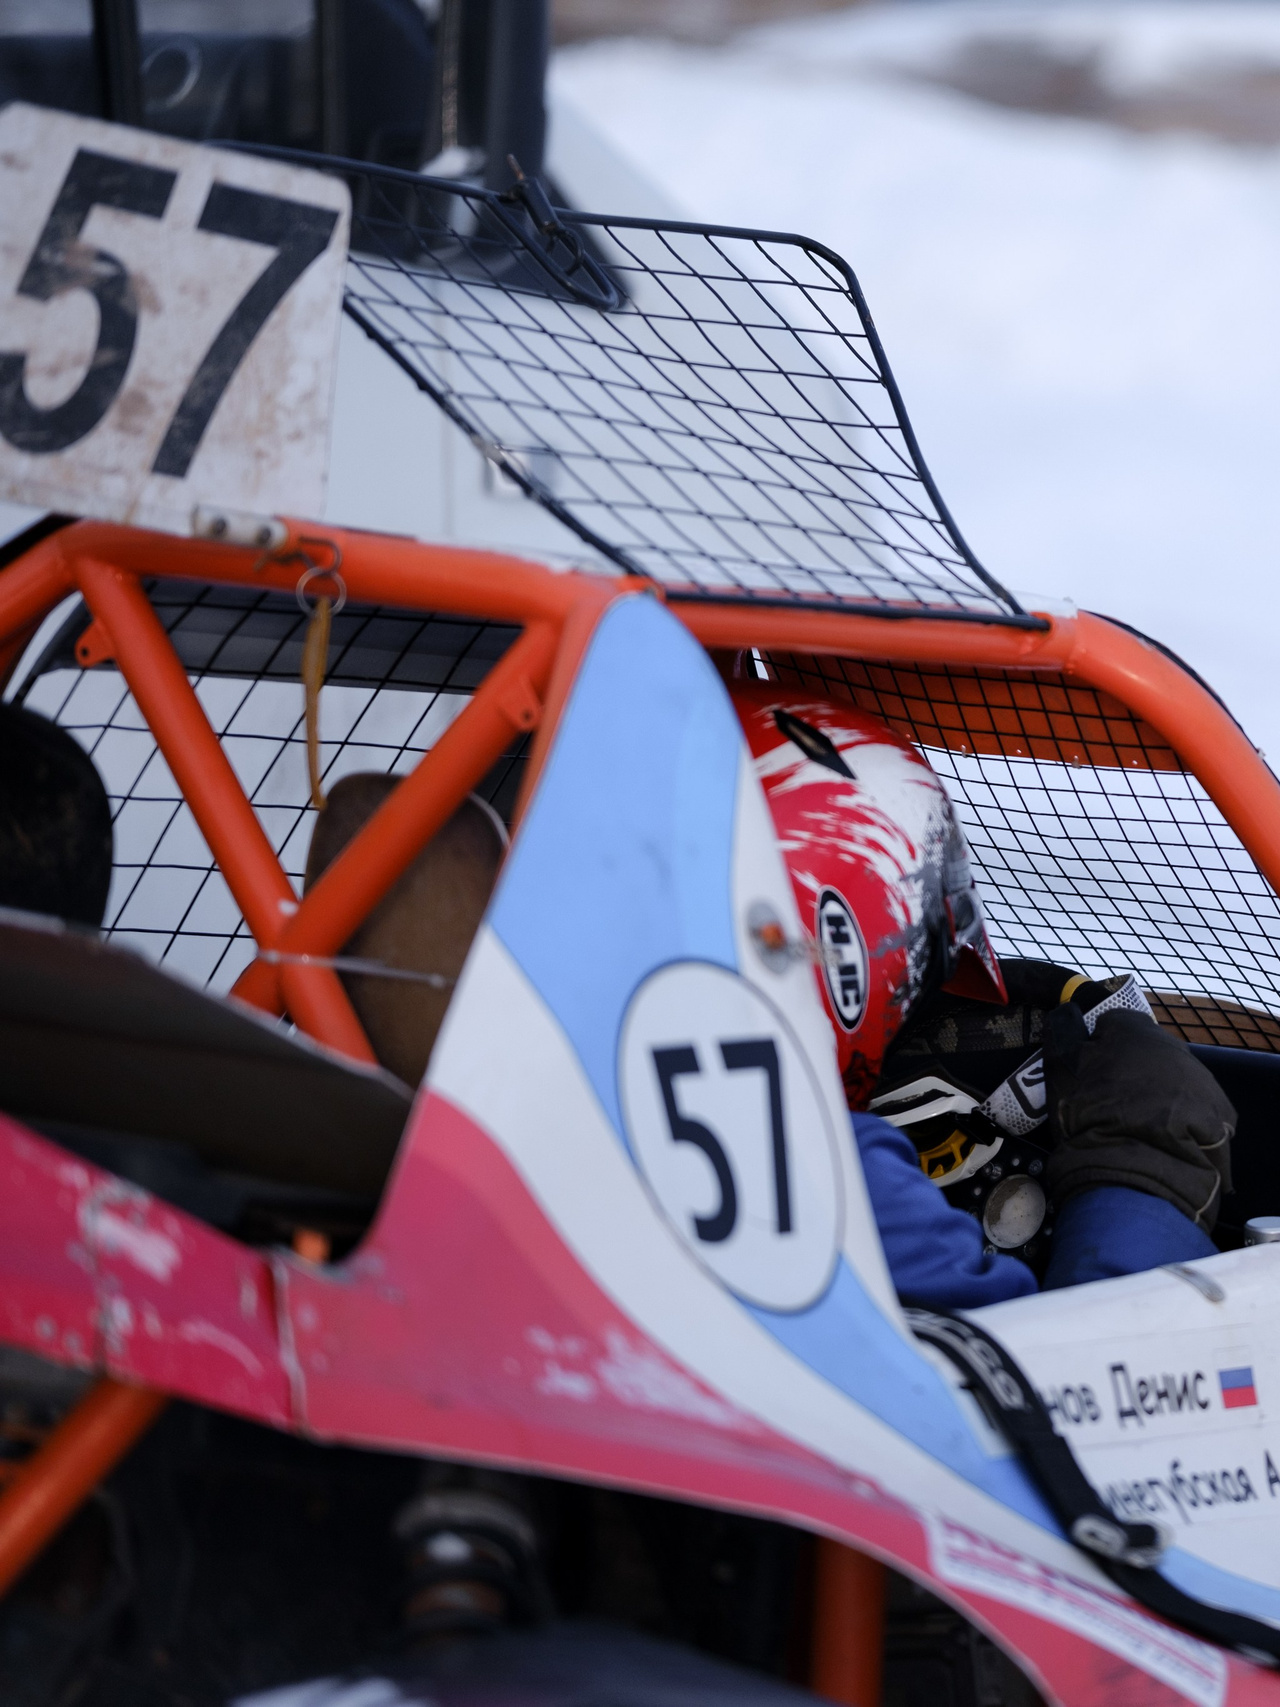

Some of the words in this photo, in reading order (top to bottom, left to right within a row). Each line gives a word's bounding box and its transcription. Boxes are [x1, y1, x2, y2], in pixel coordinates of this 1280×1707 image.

[0, 147, 341, 480] 57
[651, 1040, 793, 1243] 57
[1046, 1383, 1101, 1425] нов
[1109, 1362, 1210, 1429] Денис
[1105, 1457, 1259, 1525] инегубская
